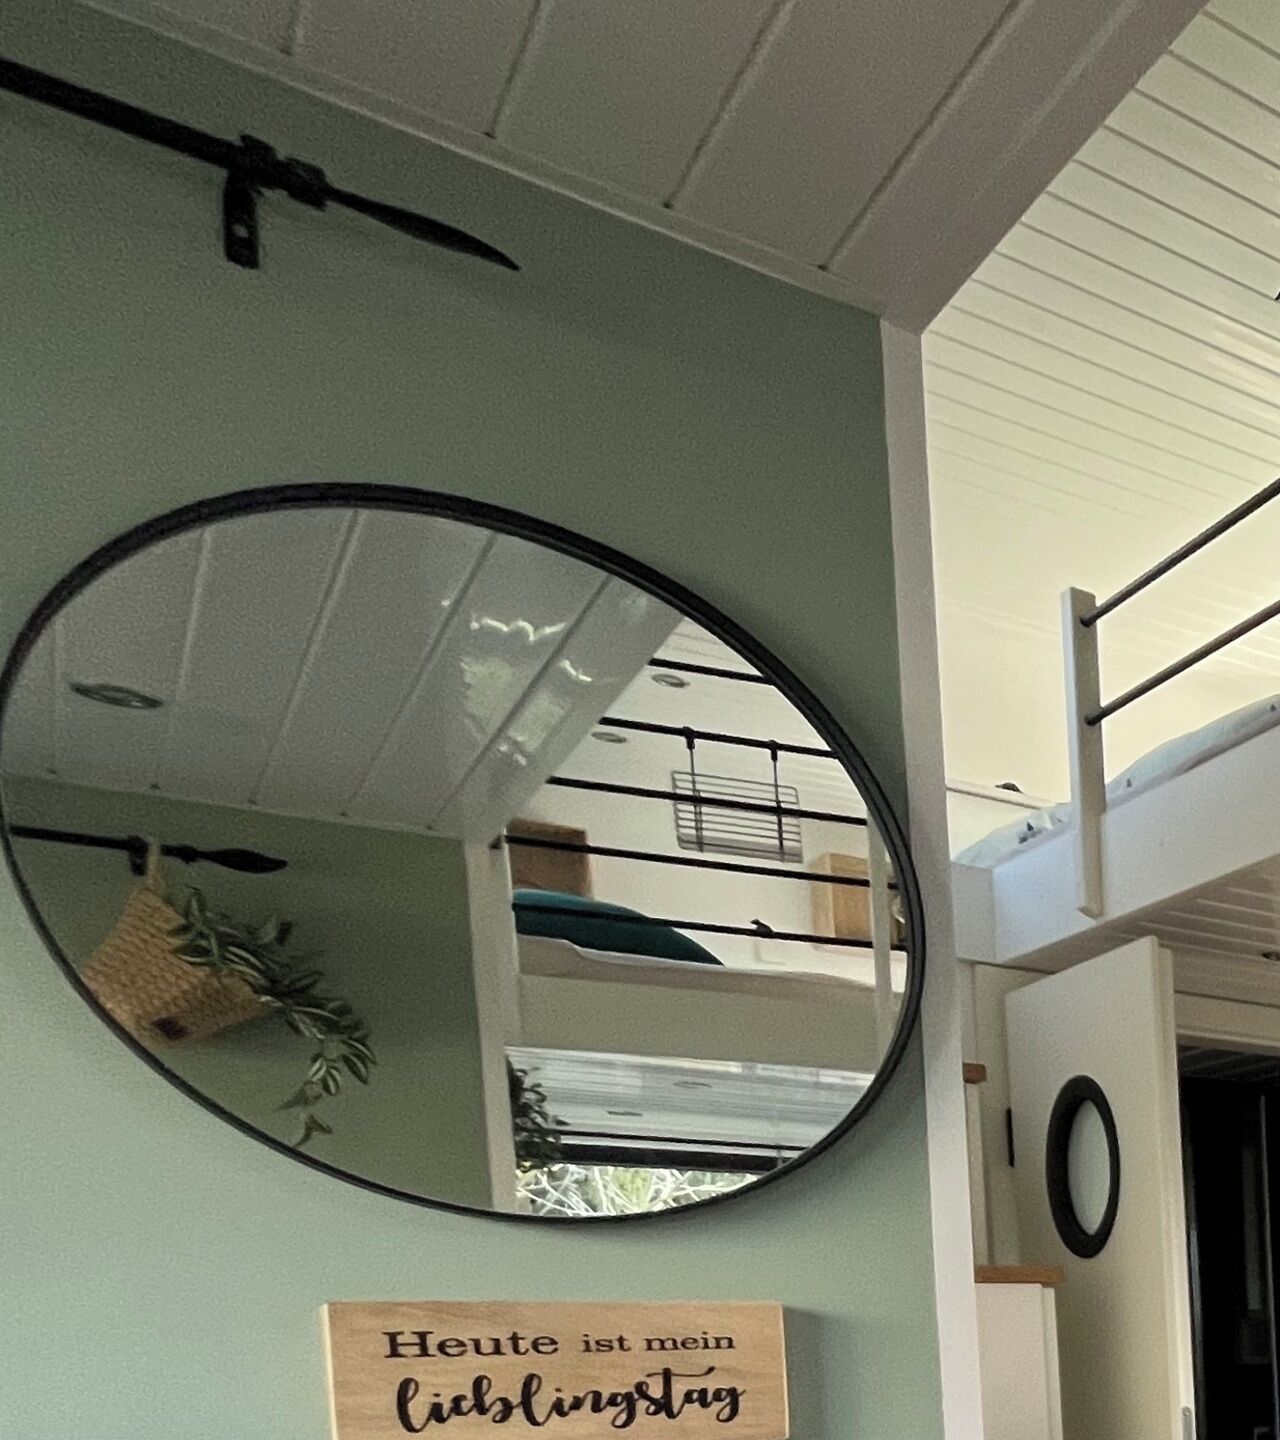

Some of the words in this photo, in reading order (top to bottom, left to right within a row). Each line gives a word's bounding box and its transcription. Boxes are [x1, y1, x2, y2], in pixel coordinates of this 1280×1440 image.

[382, 1330, 560, 1359] Heute
[581, 1333, 632, 1353] ist
[643, 1333, 736, 1352] mein
